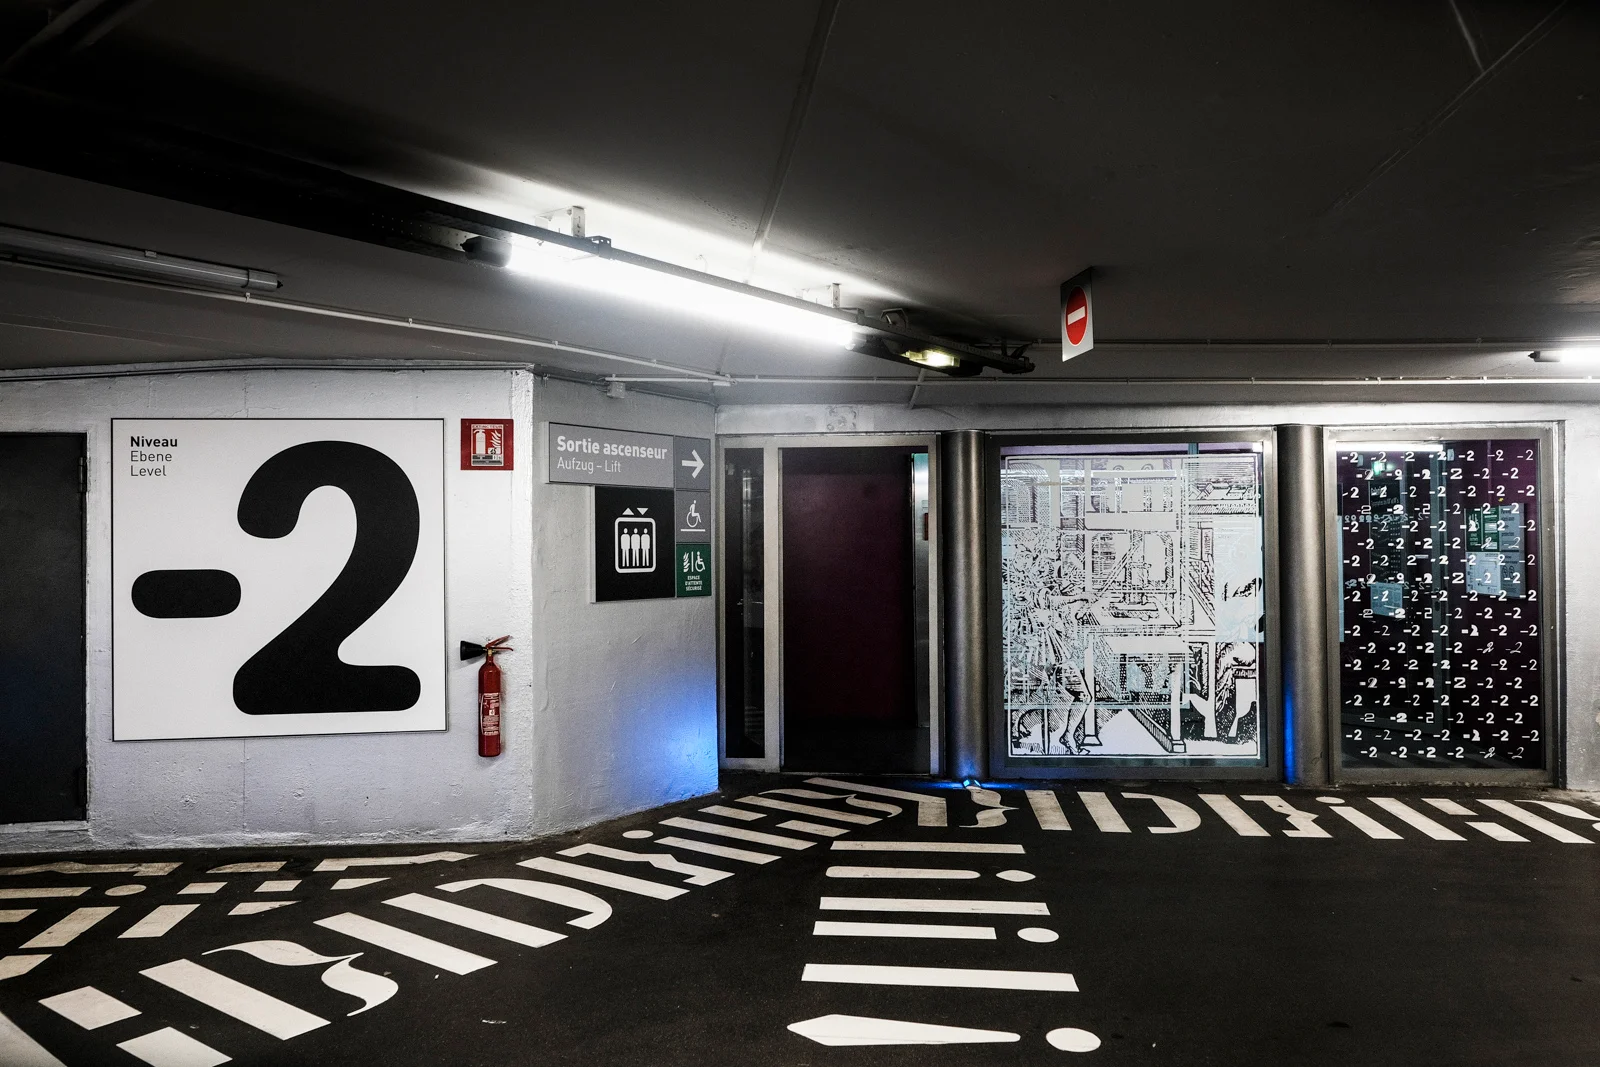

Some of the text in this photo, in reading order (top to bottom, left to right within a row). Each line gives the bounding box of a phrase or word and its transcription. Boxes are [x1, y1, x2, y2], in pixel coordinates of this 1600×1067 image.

[130, 435, 178, 448] Niveau
[556, 435, 668, 460] Sortie ascenseur
[130, 450, 172, 462] Ebene
[1341, 449, 1534, 462] -2 -2 -2 -2 -2 -2 -2
[130, 465, 167, 477] Level
[556, 456, 594, 474] Aufzug
[605, 459, 621, 473] Lift
[1356, 467, 1519, 480] -2 -2 -2 -2 -2 -2
[1342, 487, 1359, 497] -2
[1402, 486, 1417, 497] -2
[1430, 486, 1446, 496] -2
[1460, 486, 1476, 497] -2
[1489, 486, 1505, 496] -2
[1519, 485, 1534, 496] -2
[1357, 503, 1519, 514] -2 -2 -2 -2 -2 -2
[1343, 521, 1359, 532] -2
[1402, 520, 1418, 531] -2
[1431, 521, 1446, 531] -2
[1490, 520, 1504, 531] -2
[1518, 520, 1535, 531] -2
[1358, 539, 1374, 549] -2
[1388, 538, 1404, 549] -2
[1415, 538, 1433, 549] -2
[1444, 538, 1461, 548] -2
[1504, 537, 1519, 548] -2
[1344, 555, 1360, 566] -2
[1374, 555, 1389, 566] -2
[1431, 556, 1448, 565] -2
[1460, 556, 1476, 565] -2
[1518, 554, 1534, 565] -2
[131, 440, 421, 715] -2
[1359, 572, 1519, 584] -2 -2 -2 -2 -2 -2
[1345, 591, 1361, 601] -2
[1374, 591, 1389, 600] -2
[1403, 590, 1418, 601] -2
[1431, 590, 1447, 600] -2
[1461, 590, 1477, 601] -2
[1490, 590, 1506, 601] -2
[1520, 590, 1536, 601] -2
[1359, 607, 1521, 618] -2 -2 -2 -2 -2 -2
[1345, 624, 1537, 636] -2 -2 -2 -2 -2 -2 -2
[1360, 642, 1521, 653] -2 -2 -2 -2 -2 -2
[1345, 659, 1537, 670] -2 -2 -2 -2 -2 -2 -2
[1360, 677, 1522, 688] -2 -2 -2 -2 -2 -2
[1346, 695, 1538, 706] -2 -2 -2 -2 -2 -2 -2
[1360, 712, 1523, 723] -2 -2 -2 -2 -2 -2
[1346, 729, 1539, 741] -2 -2 -2 -2 -2 -2 -2
[1361, 747, 1523, 758] -2 -2 -2 -2 -2 -2
